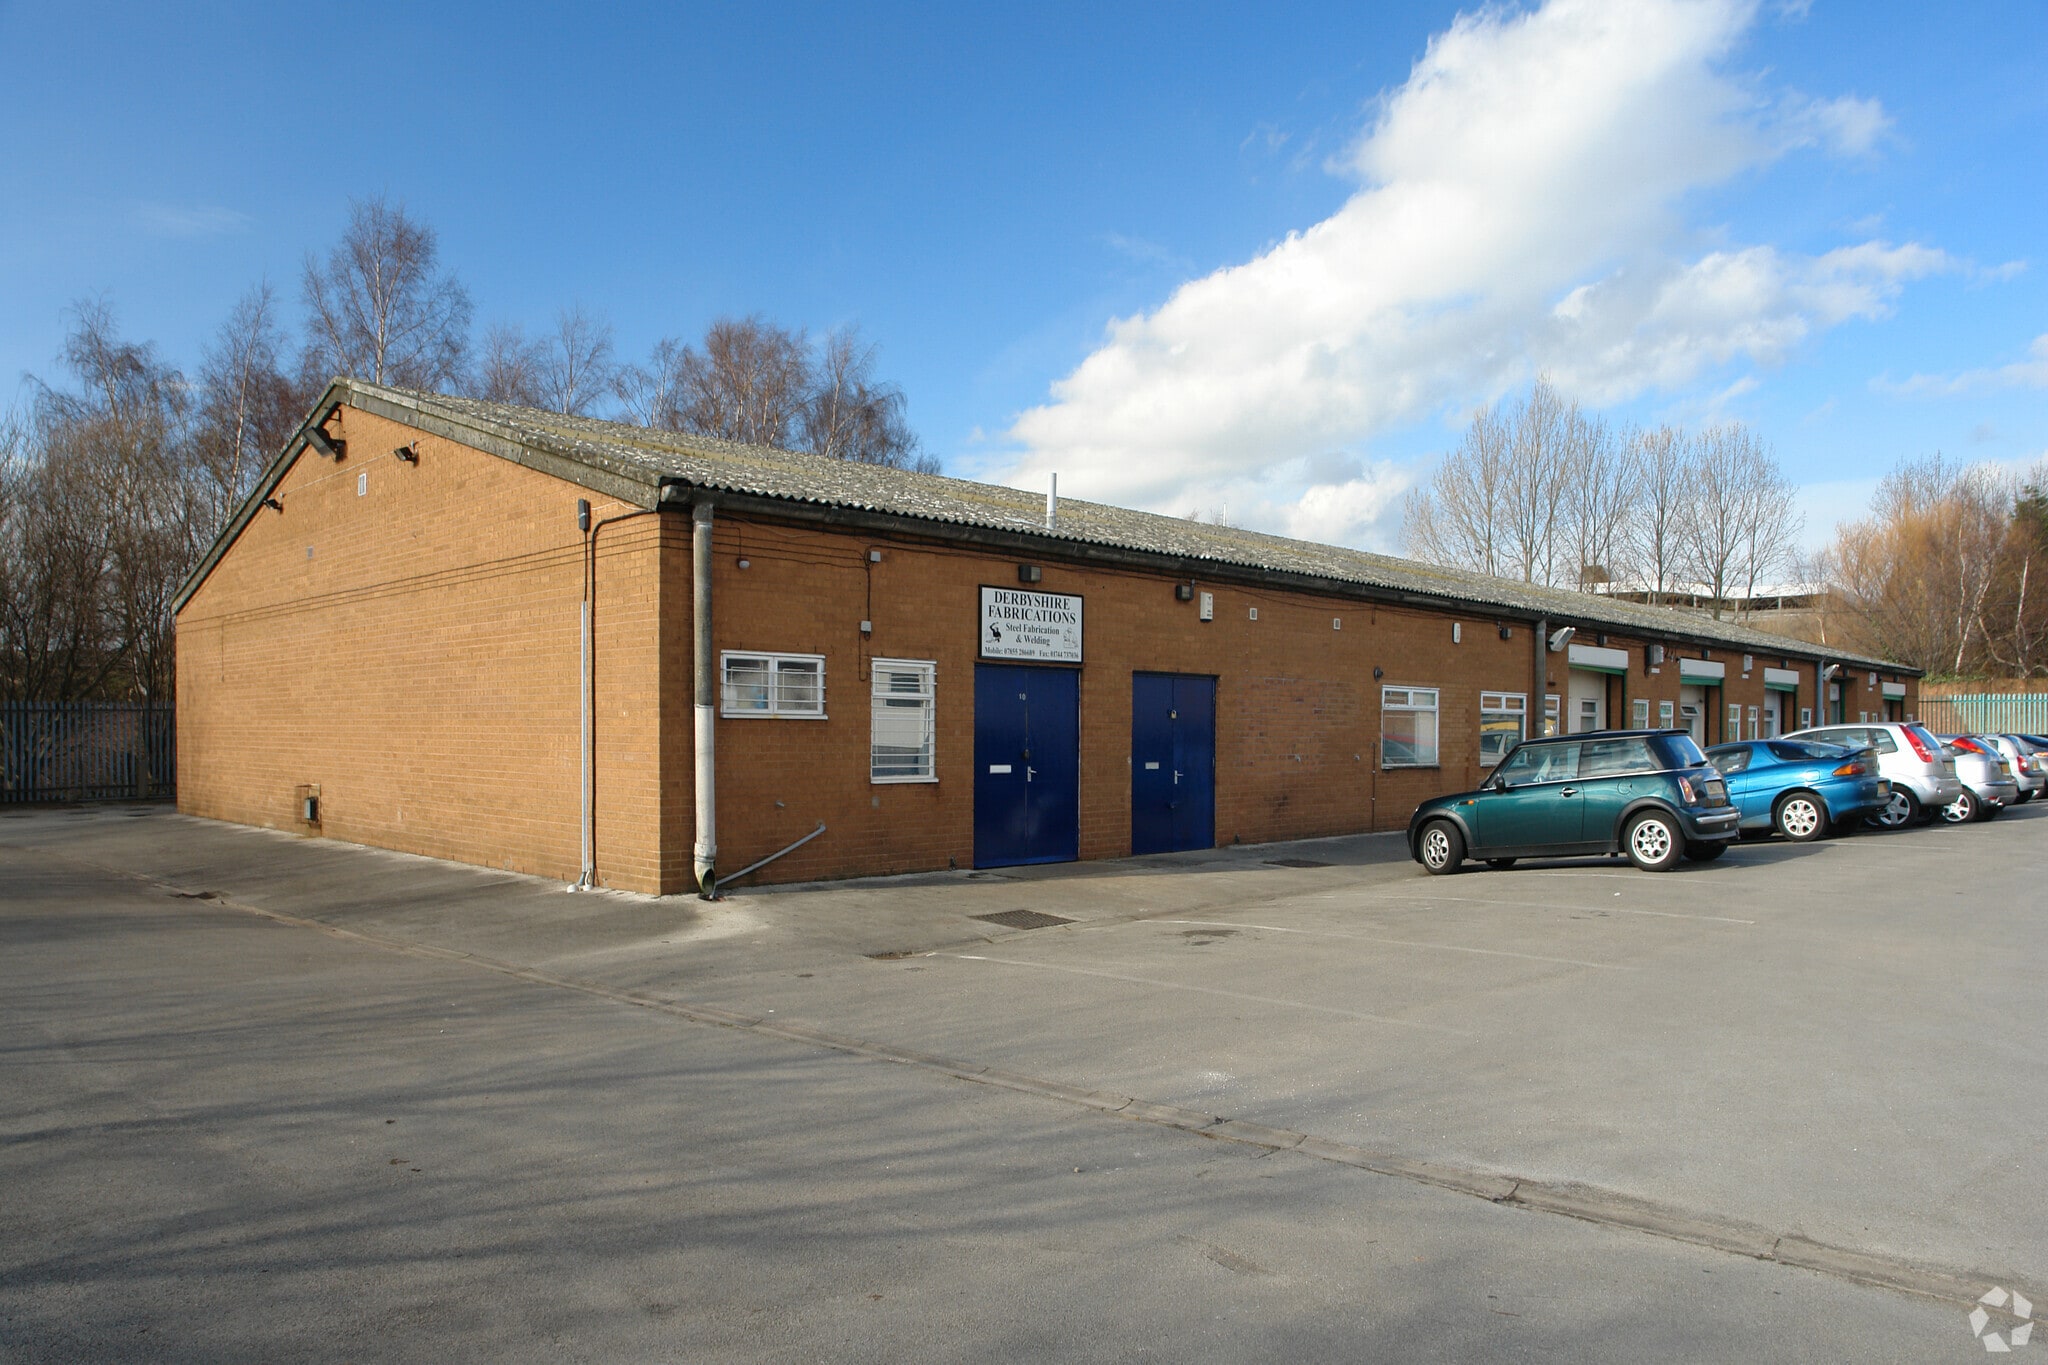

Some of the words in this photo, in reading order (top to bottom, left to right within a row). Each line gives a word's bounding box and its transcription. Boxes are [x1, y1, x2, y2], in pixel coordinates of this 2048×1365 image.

[994, 591, 1070, 610] DERBYSHIRE
[988, 605, 1076, 625] FABRICATIONS
[1005, 622, 1022, 633] Steel
[1023, 624, 1060, 635] Fabrication
[1015, 634, 1022, 643] &
[1024, 635, 1051, 646] Welding
